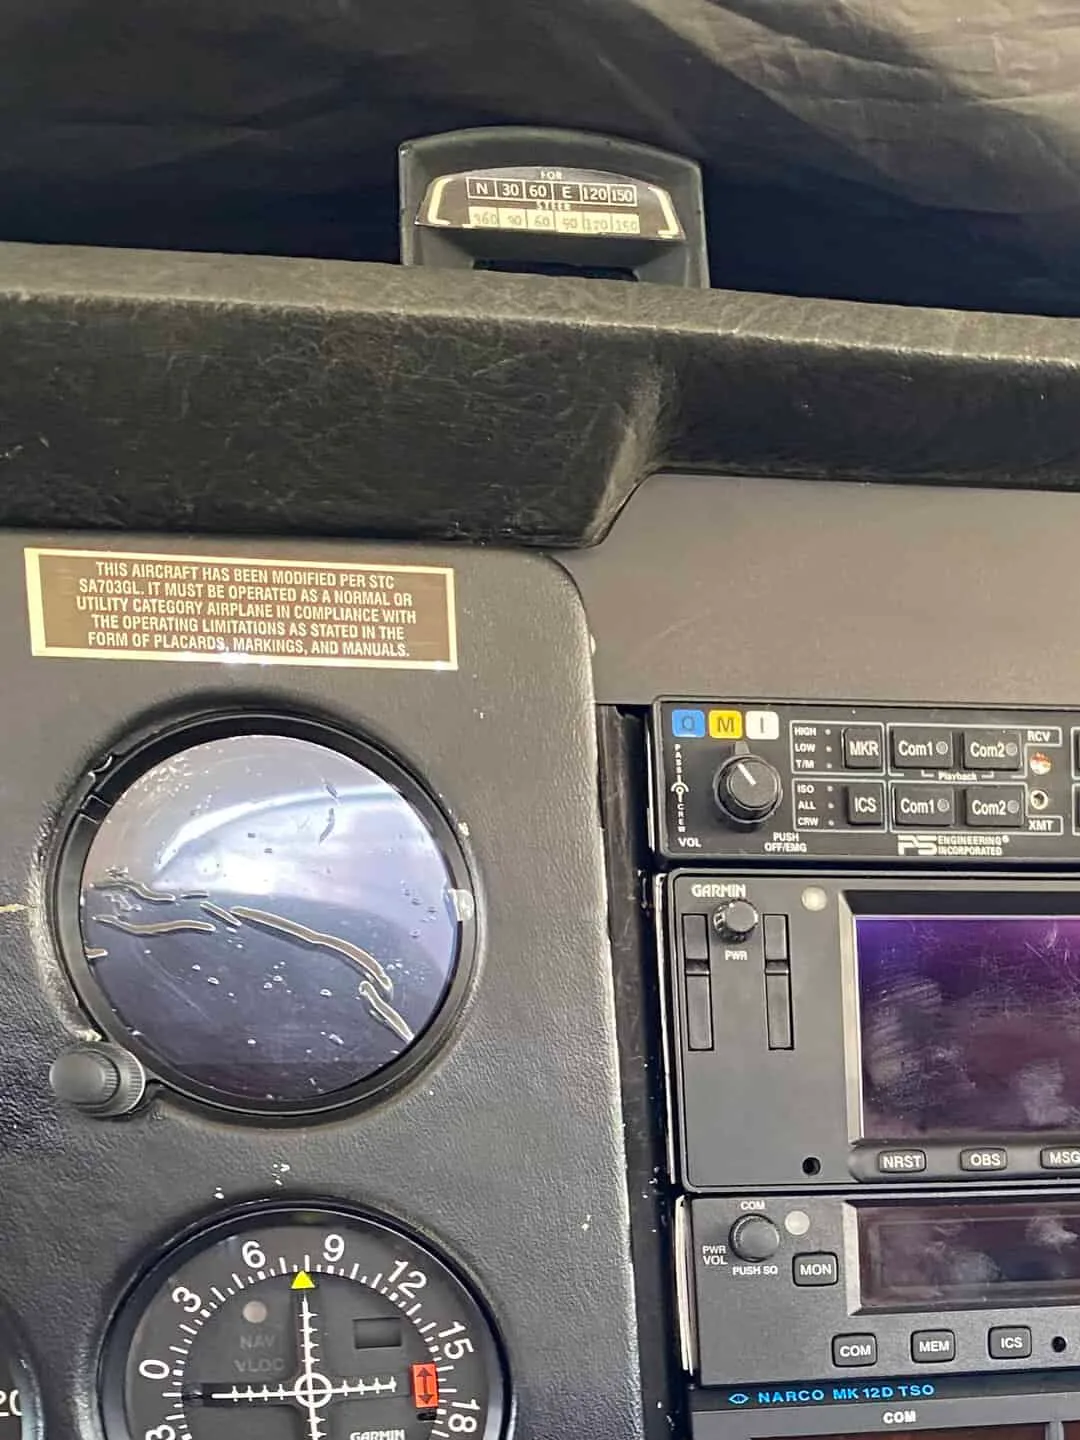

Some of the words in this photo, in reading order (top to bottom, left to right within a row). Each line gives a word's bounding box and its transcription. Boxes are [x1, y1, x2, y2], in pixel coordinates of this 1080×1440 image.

[540, 169, 564, 180] FOR
[476, 182, 488, 194] N
[502, 183, 520, 197] 30
[529, 185, 547, 198] 60
[562, 186, 572, 198] E
[583, 188, 607, 201] 120
[611, 189, 633, 203] 150
[536, 201, 572, 211] STEER
[96, 561, 128, 577] THIS
[132, 563, 198, 580] AIRCRAFT
[202, 567, 230, 582] HAS
[234, 568, 268, 583] BEEN
[272, 570, 336, 586] MODIFIED
[340, 574, 365, 588] PER
[369, 575, 394, 589] STC
[79, 578, 145, 595] SA703GL.
[148, 581, 160, 595] IT
[165, 582, 204, 598] MUST
[207, 584, 225, 599] BE
[228, 585, 297, 602] OPERATED
[301, 589, 317, 603] AS
[322, 589, 331, 603] A
[334, 590, 390, 606] NORMAL
[394, 593, 413, 607] OR
[76, 596, 129, 612] UTILITY
[132, 598, 203, 615] CATEGORY
[207, 602, 273, 618] AIRPLANE
[276, 605, 290, 619] IN
[294, 606, 380, 623] COMPLIANCE
[382, 609, 417, 624] WITH
[91, 614, 119, 629] THE
[122, 615, 198, 632] OPERATING
[202, 618, 285, 635] LIMITATIONS
[289, 622, 306, 637] AS
[310, 623, 358, 638] STATED
[361, 625, 376, 640] IN
[379, 626, 404, 641] THE
[88, 632, 128, 647] FORM
[132, 634, 150, 648] OF
[154, 634, 230, 652] PLACARDS,
[233, 637, 308, 655] MARKINGS,
[311, 641, 338, 655] AND
[341, 641, 410, 657] MANUALS.
[717, 717, 735, 733] M
[794, 727, 817, 737] HIGH
[1027, 731, 1051, 743] RCV
[795, 743, 816, 753] LOW
[850, 741, 879, 755] MKR
[898, 740, 935, 757] Com1
[970, 742, 1005, 758] Com2
[854, 798, 877, 813] ICS
[900, 798, 935, 814] Com1
[971, 800, 1007, 816] Com2
[1028, 820, 1053, 832] XMT
[678, 838, 702, 848] VOL
[691, 884, 746, 898] GARMIN
[883, 1154, 921, 1170] NRST
[970, 1151, 1001, 1166] OBS
[1049, 1149, 1080, 1164] MSG
[325, 1234, 345, 1261] 9
[702, 1245, 726, 1255] PWR
[703, 1255, 728, 1266] VOL
[800, 1263, 832, 1276] MON
[388, 1260, 429, 1298] 12
[438, 1320, 475, 1359] 15
[919, 1340, 950, 1353] MEM
[840, 1345, 871, 1358] COM
[139, 1359, 169, 1380] 0
[758, 1389, 824, 1403] NARCO
[833, 1388, 859, 1400] MK
[862, 1386, 894, 1399] 12D
[898, 1384, 935, 1397] TSO
[448, 1398, 480, 1434] 18
[883, 1411, 916, 1424] COM
